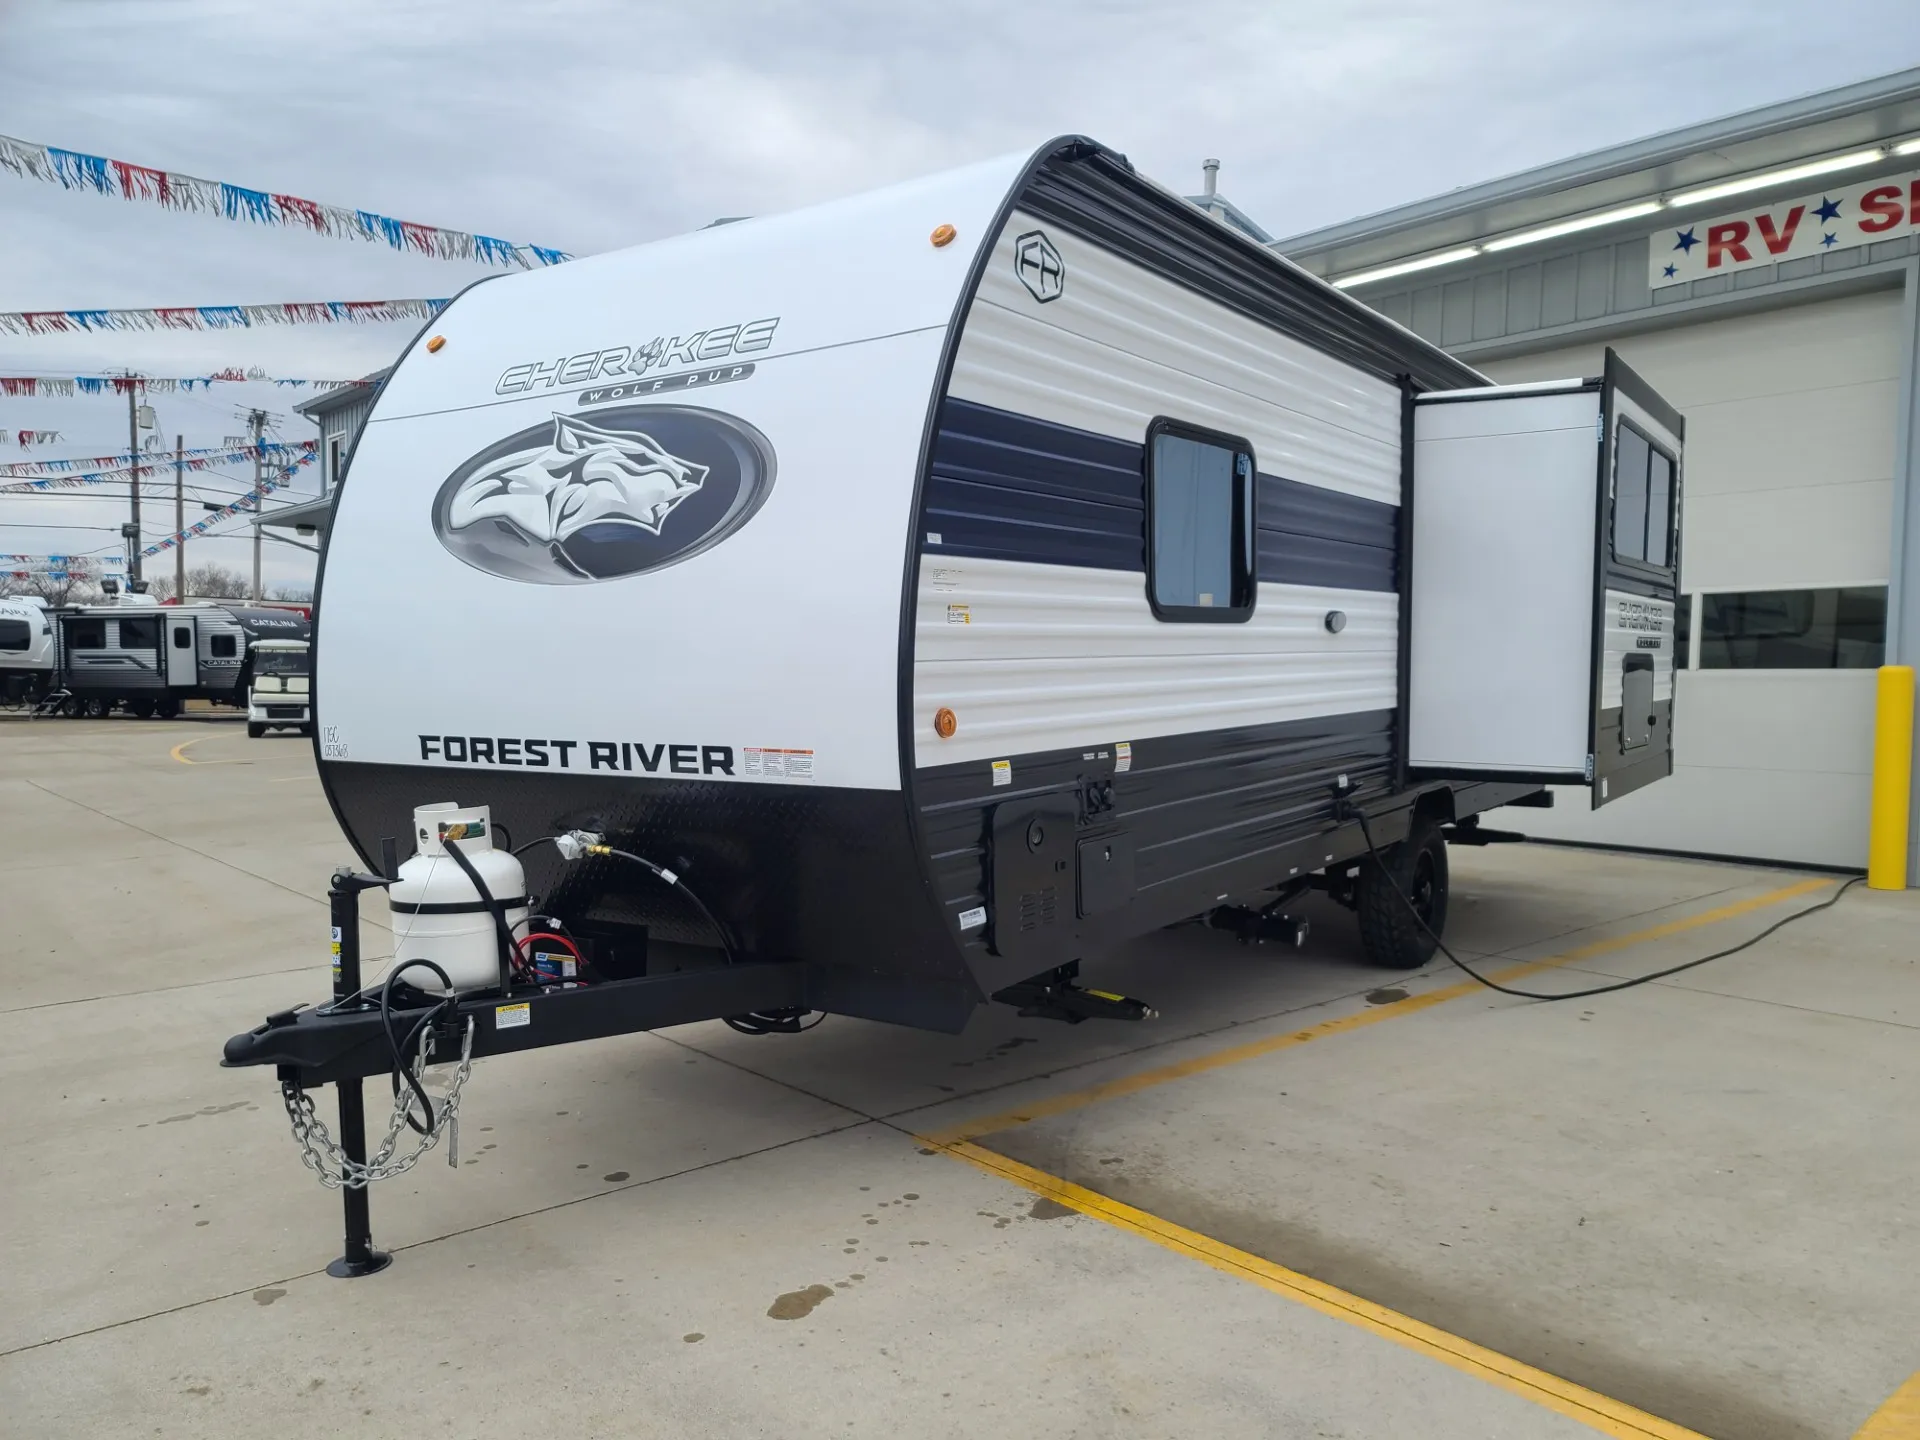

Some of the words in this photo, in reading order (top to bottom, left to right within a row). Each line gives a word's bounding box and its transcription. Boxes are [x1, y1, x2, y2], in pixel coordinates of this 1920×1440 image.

[1707, 205, 1806, 269] RV
[1858, 180, 1920, 234] S
[589, 380, 664, 402] WOLF
[687, 366, 745, 387] PUP
[250, 619, 298, 628] CATALINA
[418, 734, 578, 768] FOREST
[587, 740, 736, 776] RIVER
